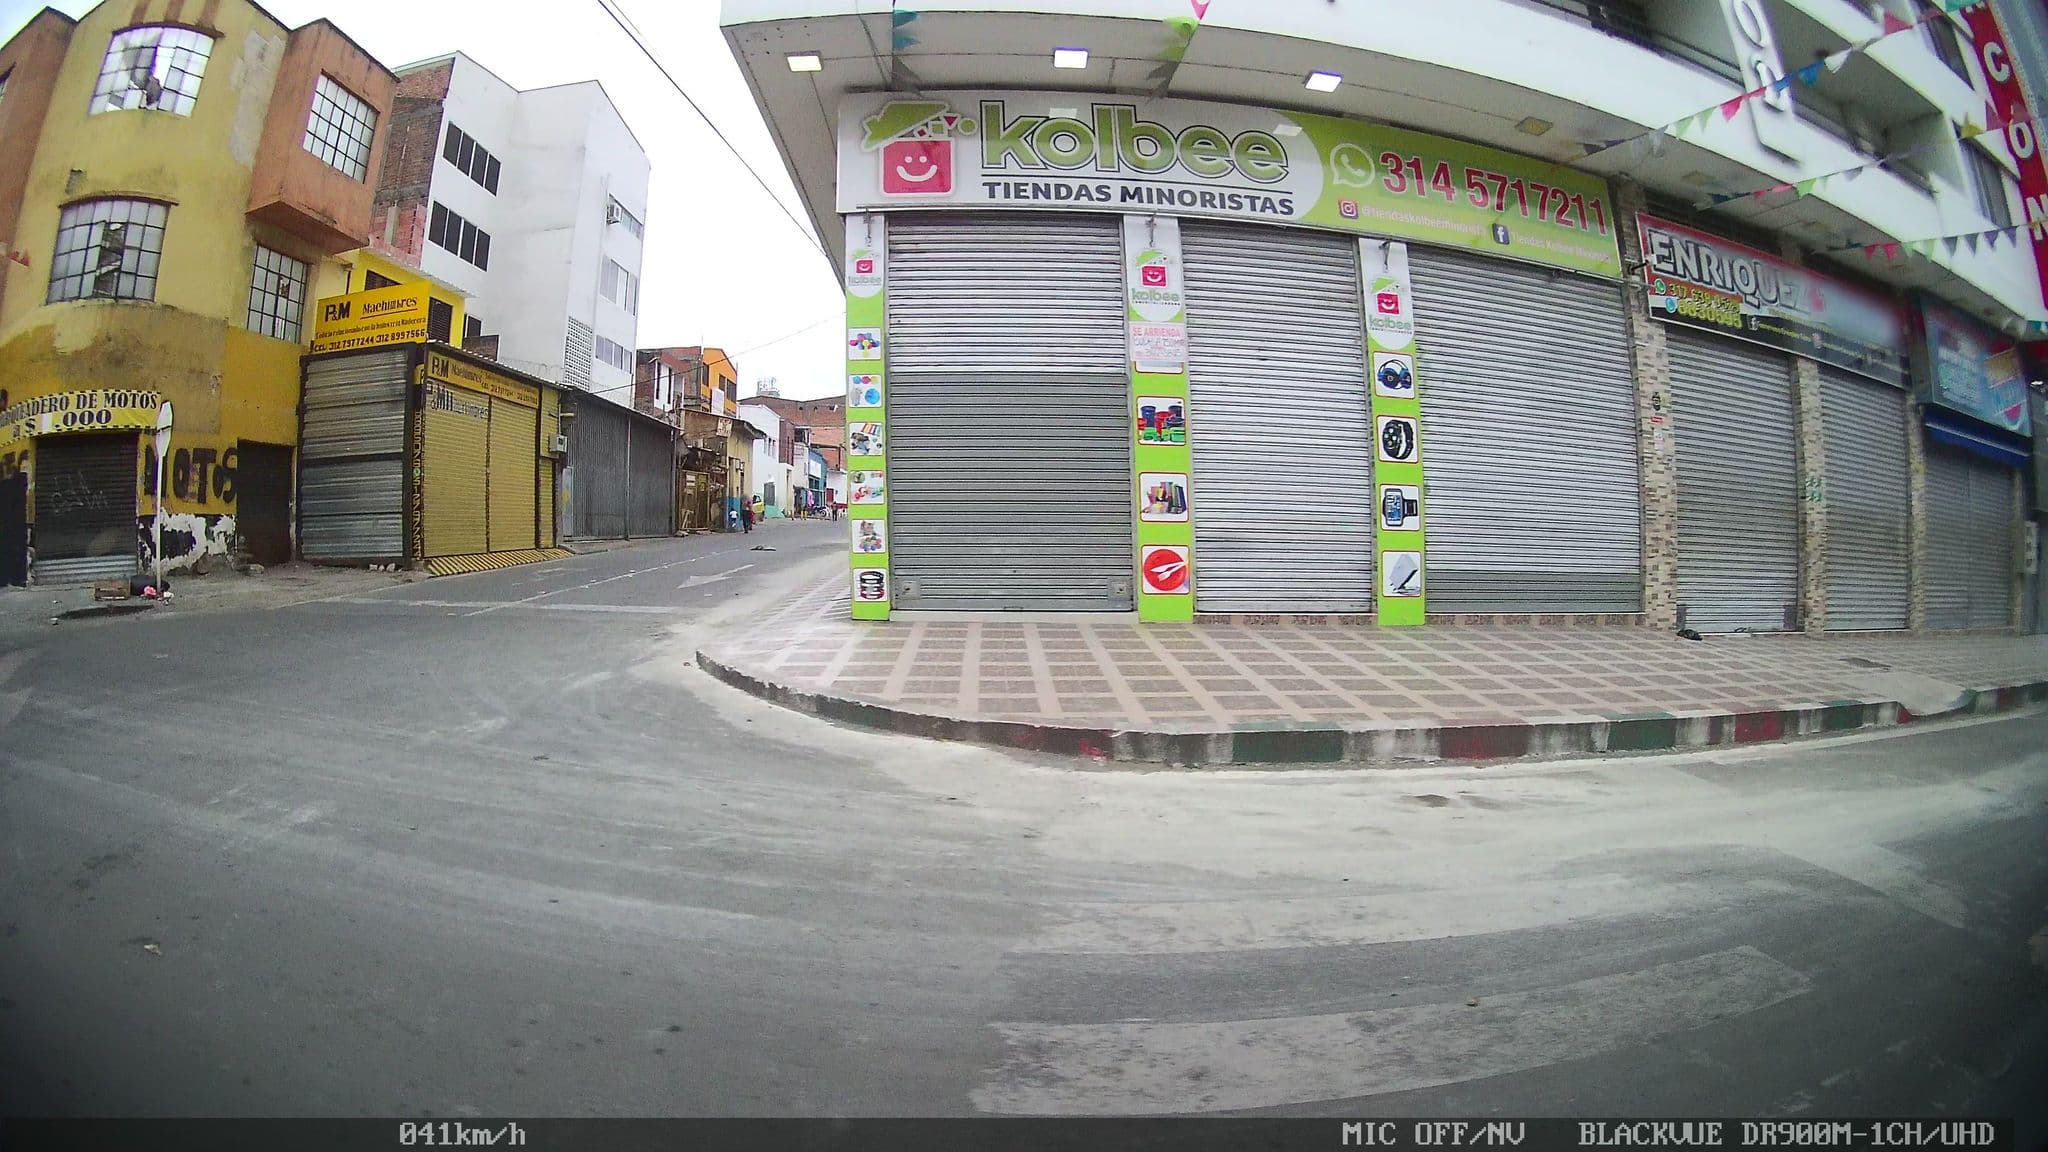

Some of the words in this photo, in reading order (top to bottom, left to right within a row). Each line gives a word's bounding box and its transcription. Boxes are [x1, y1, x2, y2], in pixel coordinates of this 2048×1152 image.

[980, 99, 1289, 184] kolbee
[981, 181, 1112, 203] TIENDAS
[1120, 186, 1295, 217] MINORISTAS
[1380, 152, 1455, 201] 314
[1465, 167, 1609, 235] 5717211
[1131, 288, 1180, 301] kolbee
[325, 301, 351, 322] P&M
[1368, 314, 1412, 330] kolbee
[431, 357, 449, 378] P&M
[76, 393, 97, 410] DE
[104, 391, 158, 410] MOTOS
